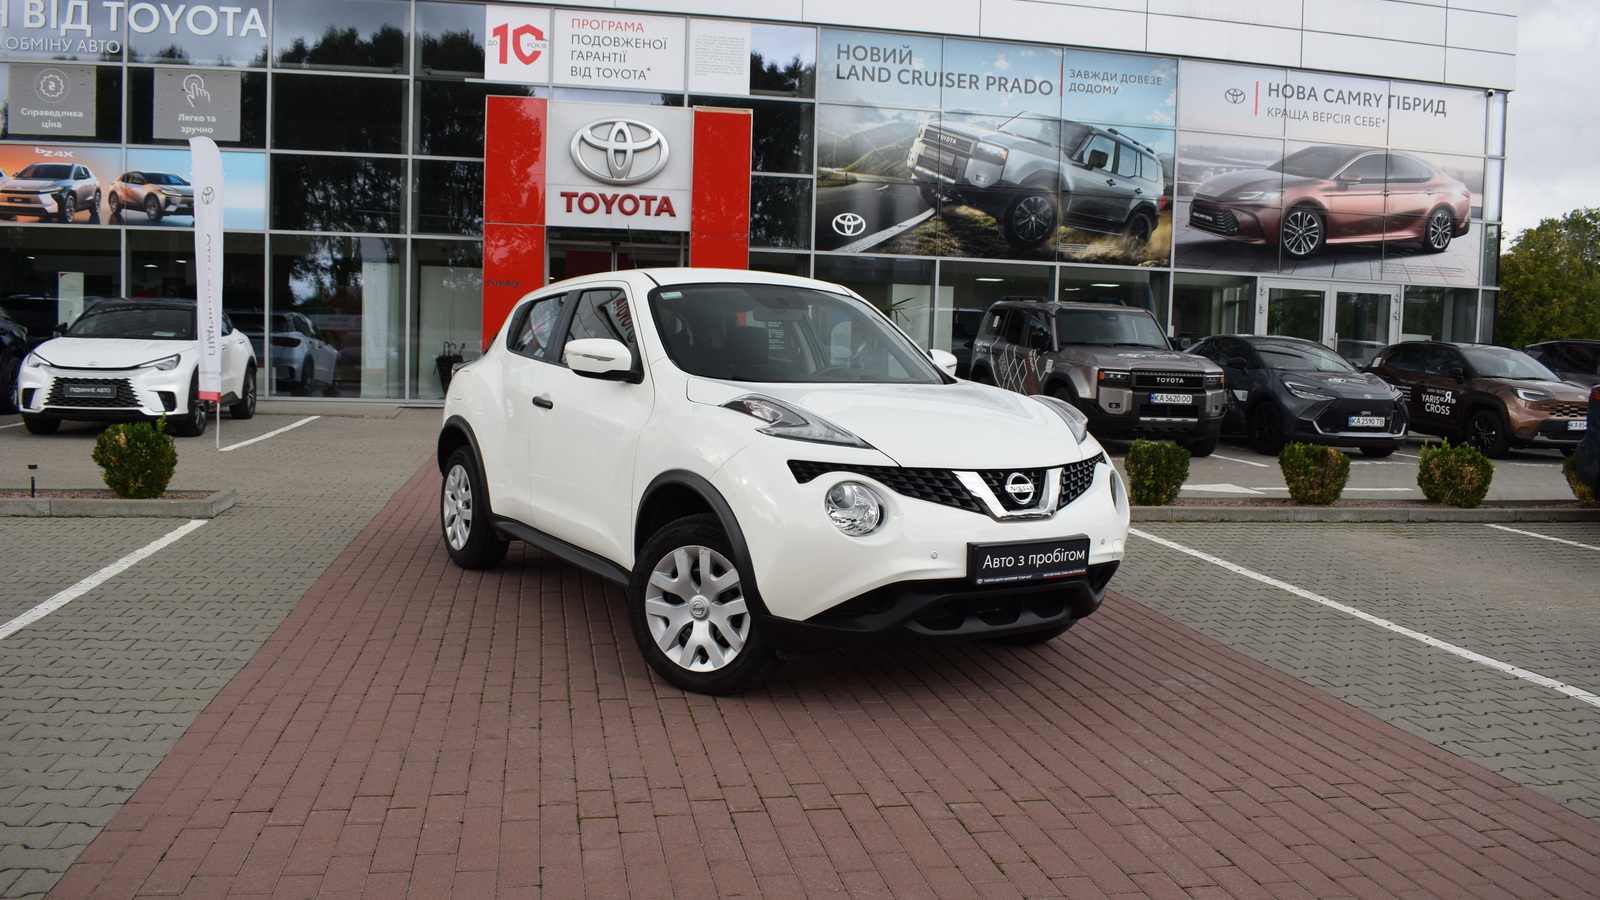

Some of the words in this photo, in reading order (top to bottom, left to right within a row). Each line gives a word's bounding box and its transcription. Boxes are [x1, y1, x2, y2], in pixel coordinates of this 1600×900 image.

[23, 0, 92, 38] ВІД
[102, 1, 268, 38] TOYOTA
[571, 18, 645, 33] ПРОГРАМА
[5, 36, 73, 52] ОБМІНУ
[76, 39, 121, 54] АВТО
[571, 34, 669, 50] ПОДОВЖЕНОЇ
[570, 50, 627, 64] ГАРАНТІЇ
[836, 43, 914, 66] НОВИЙ
[570, 66, 592, 79] ВІД
[836, 63, 892, 84] LAND
[896, 69, 981, 91] CRUISER
[985, 75, 1054, 96] PRADO
[1069, 69, 1119, 83] ЗАВЖДИ
[1119, 73, 1163, 86] ДОВЕЗЕ
[1069, 82, 1120, 96] ДОДОМУ
[1267, 82, 1319, 104] НОВА
[1323, 88, 1384, 109] CAMRY
[1387, 94, 1448, 118] ГІБРИД
[20, 107, 84, 120] Справедлива
[177, 113, 205, 124] Легко
[206, 115, 217, 123] та
[1266, 107, 1310, 122] КРАЩА
[1312, 111, 1351, 125] ВЕРСІЯ
[41, 120, 62, 130] ціна
[180, 125, 214, 135] зручно
[560, 191, 677, 218] TOYOTA
[1154, 394, 1165, 402] KA
[1165, 395, 1181, 403] 5620
[1421, 393, 1440, 405] YARIS
[1424, 403, 1451, 415] CROSS
[1351, 417, 1361, 425] KA
[1361, 417, 1376, 425] 2590
[982, 554, 1015, 569] Авто
[1017, 555, 1025, 566] з
[1028, 548, 1086, 567] пробігом
